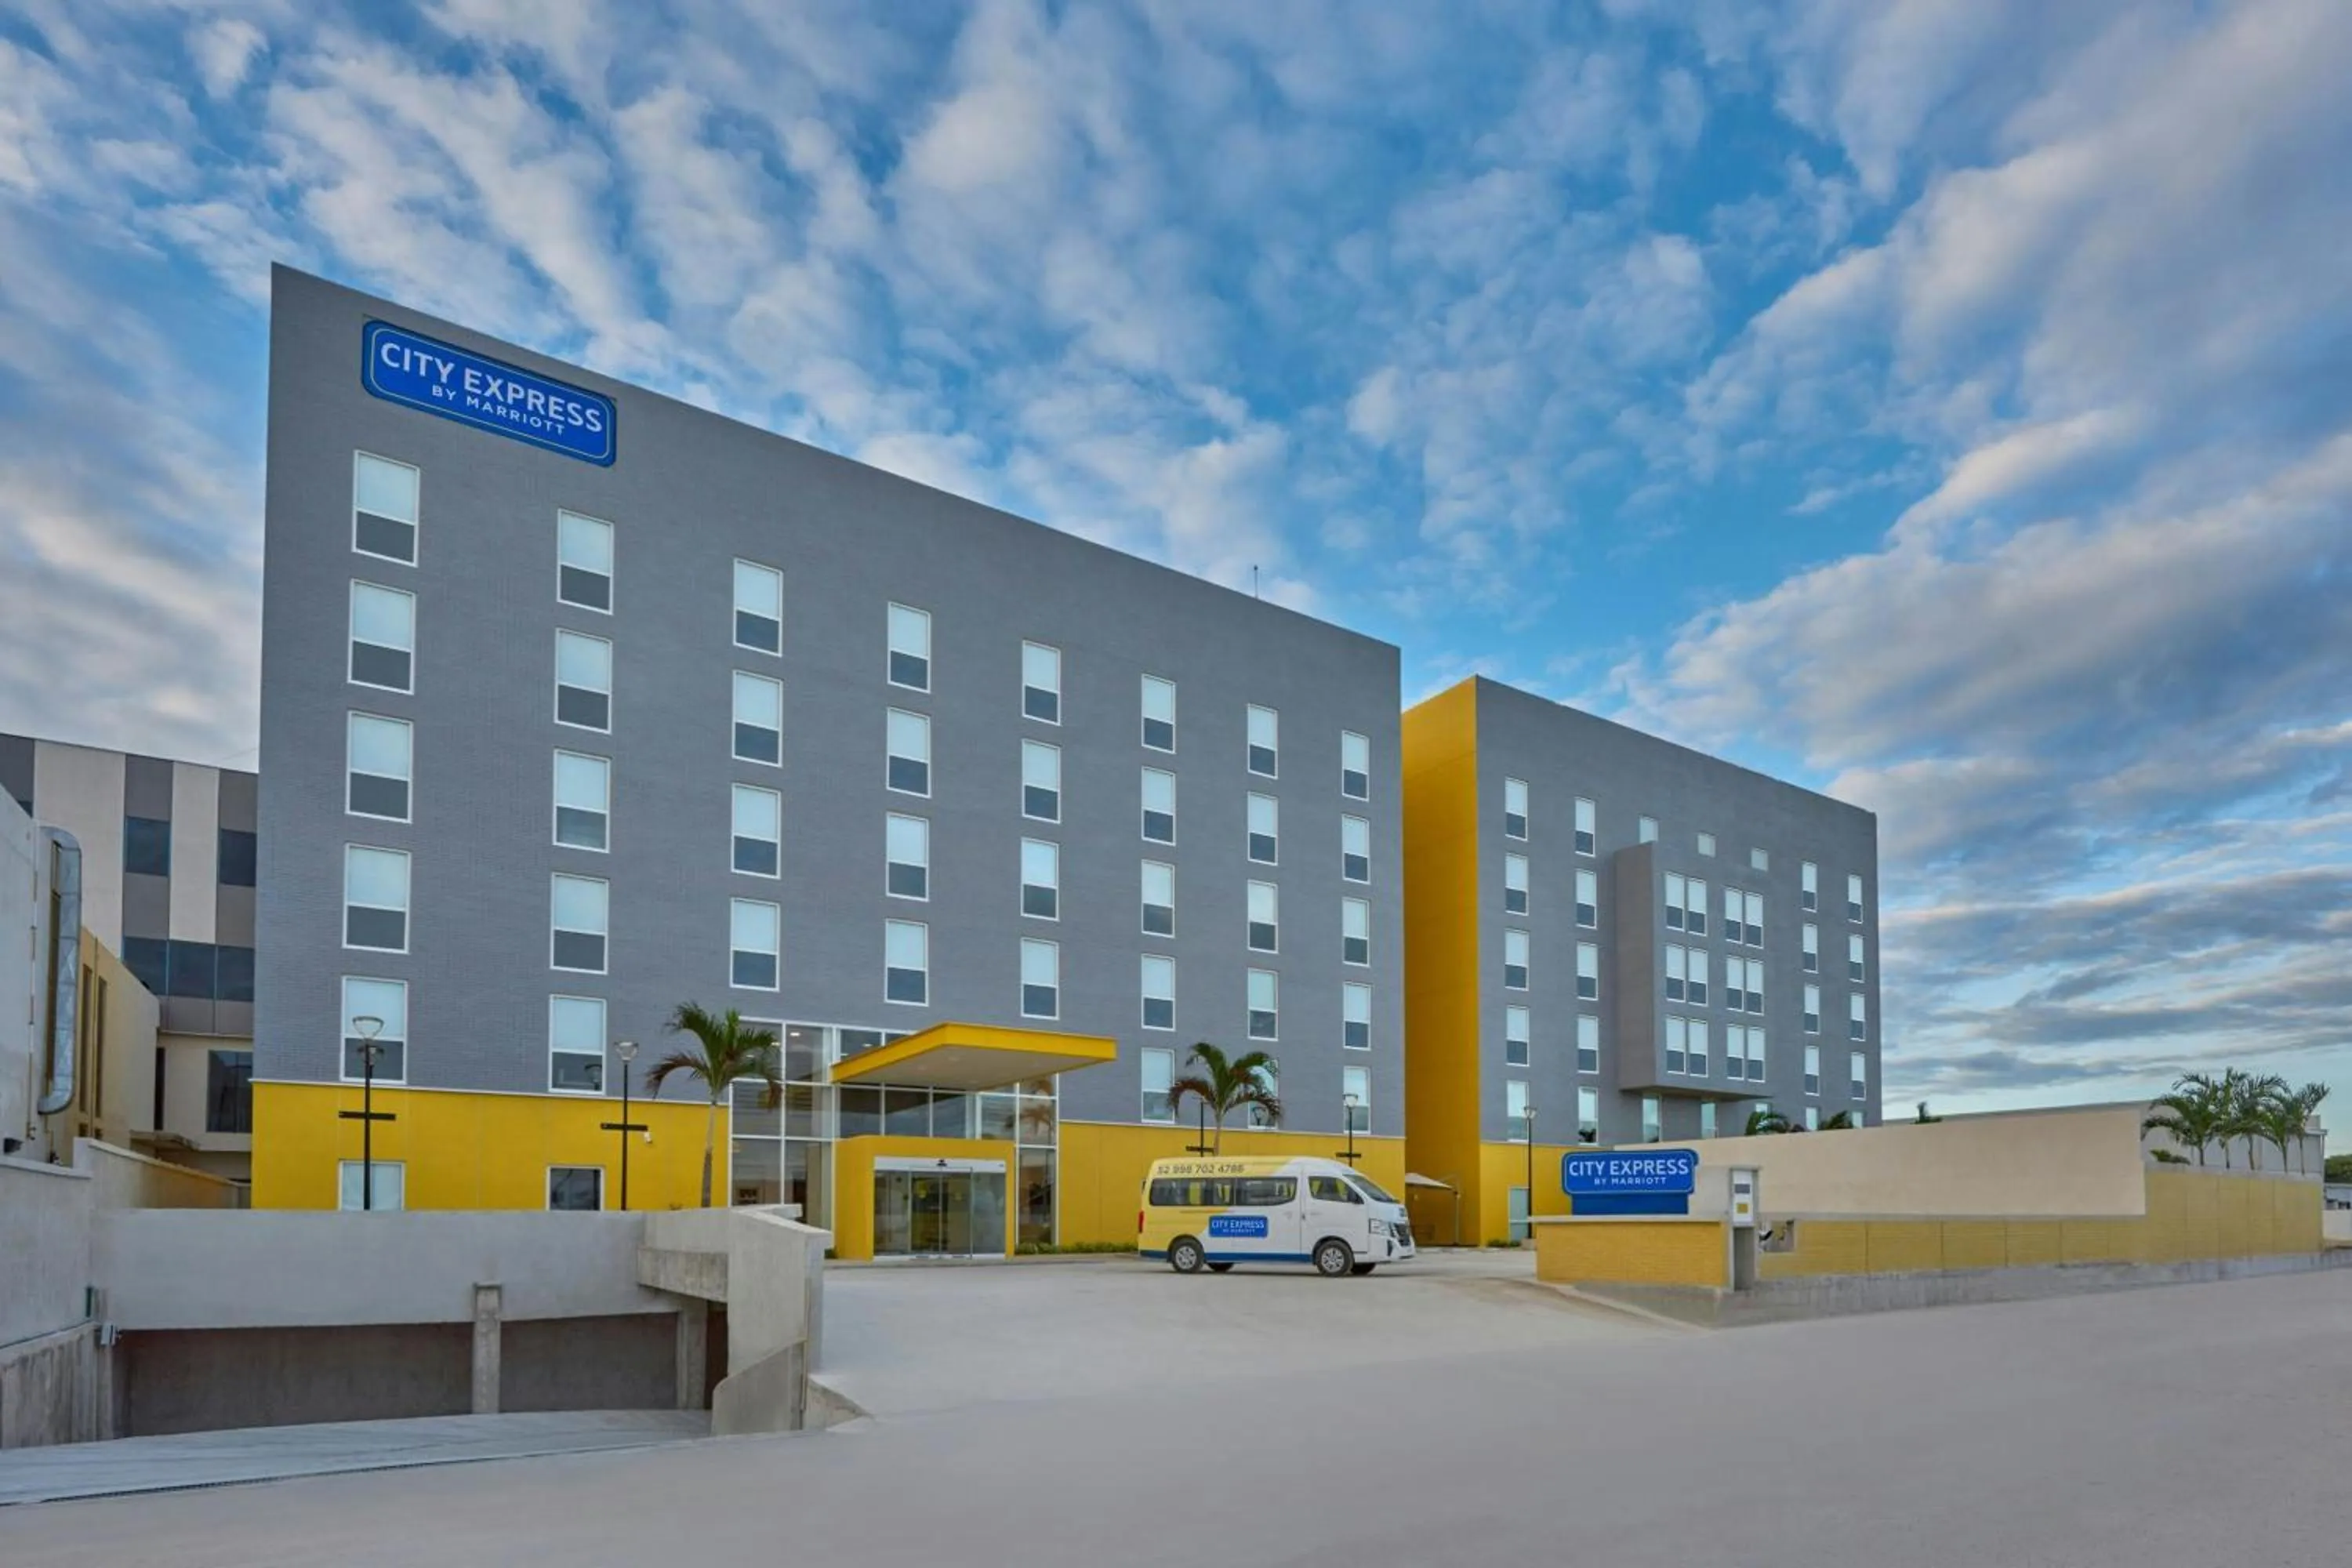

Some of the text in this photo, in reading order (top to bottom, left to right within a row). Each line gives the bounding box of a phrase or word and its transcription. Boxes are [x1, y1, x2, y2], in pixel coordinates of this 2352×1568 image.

[380, 343, 603, 432] CITY EXPRESS
[432, 385, 565, 435] BY MARRIOTT
[1195, 1163, 1214, 1174] 702
[1569, 1159, 1689, 1176] CITY EXPRESS
[1611, 1177, 1667, 1185] MARRIOTT
